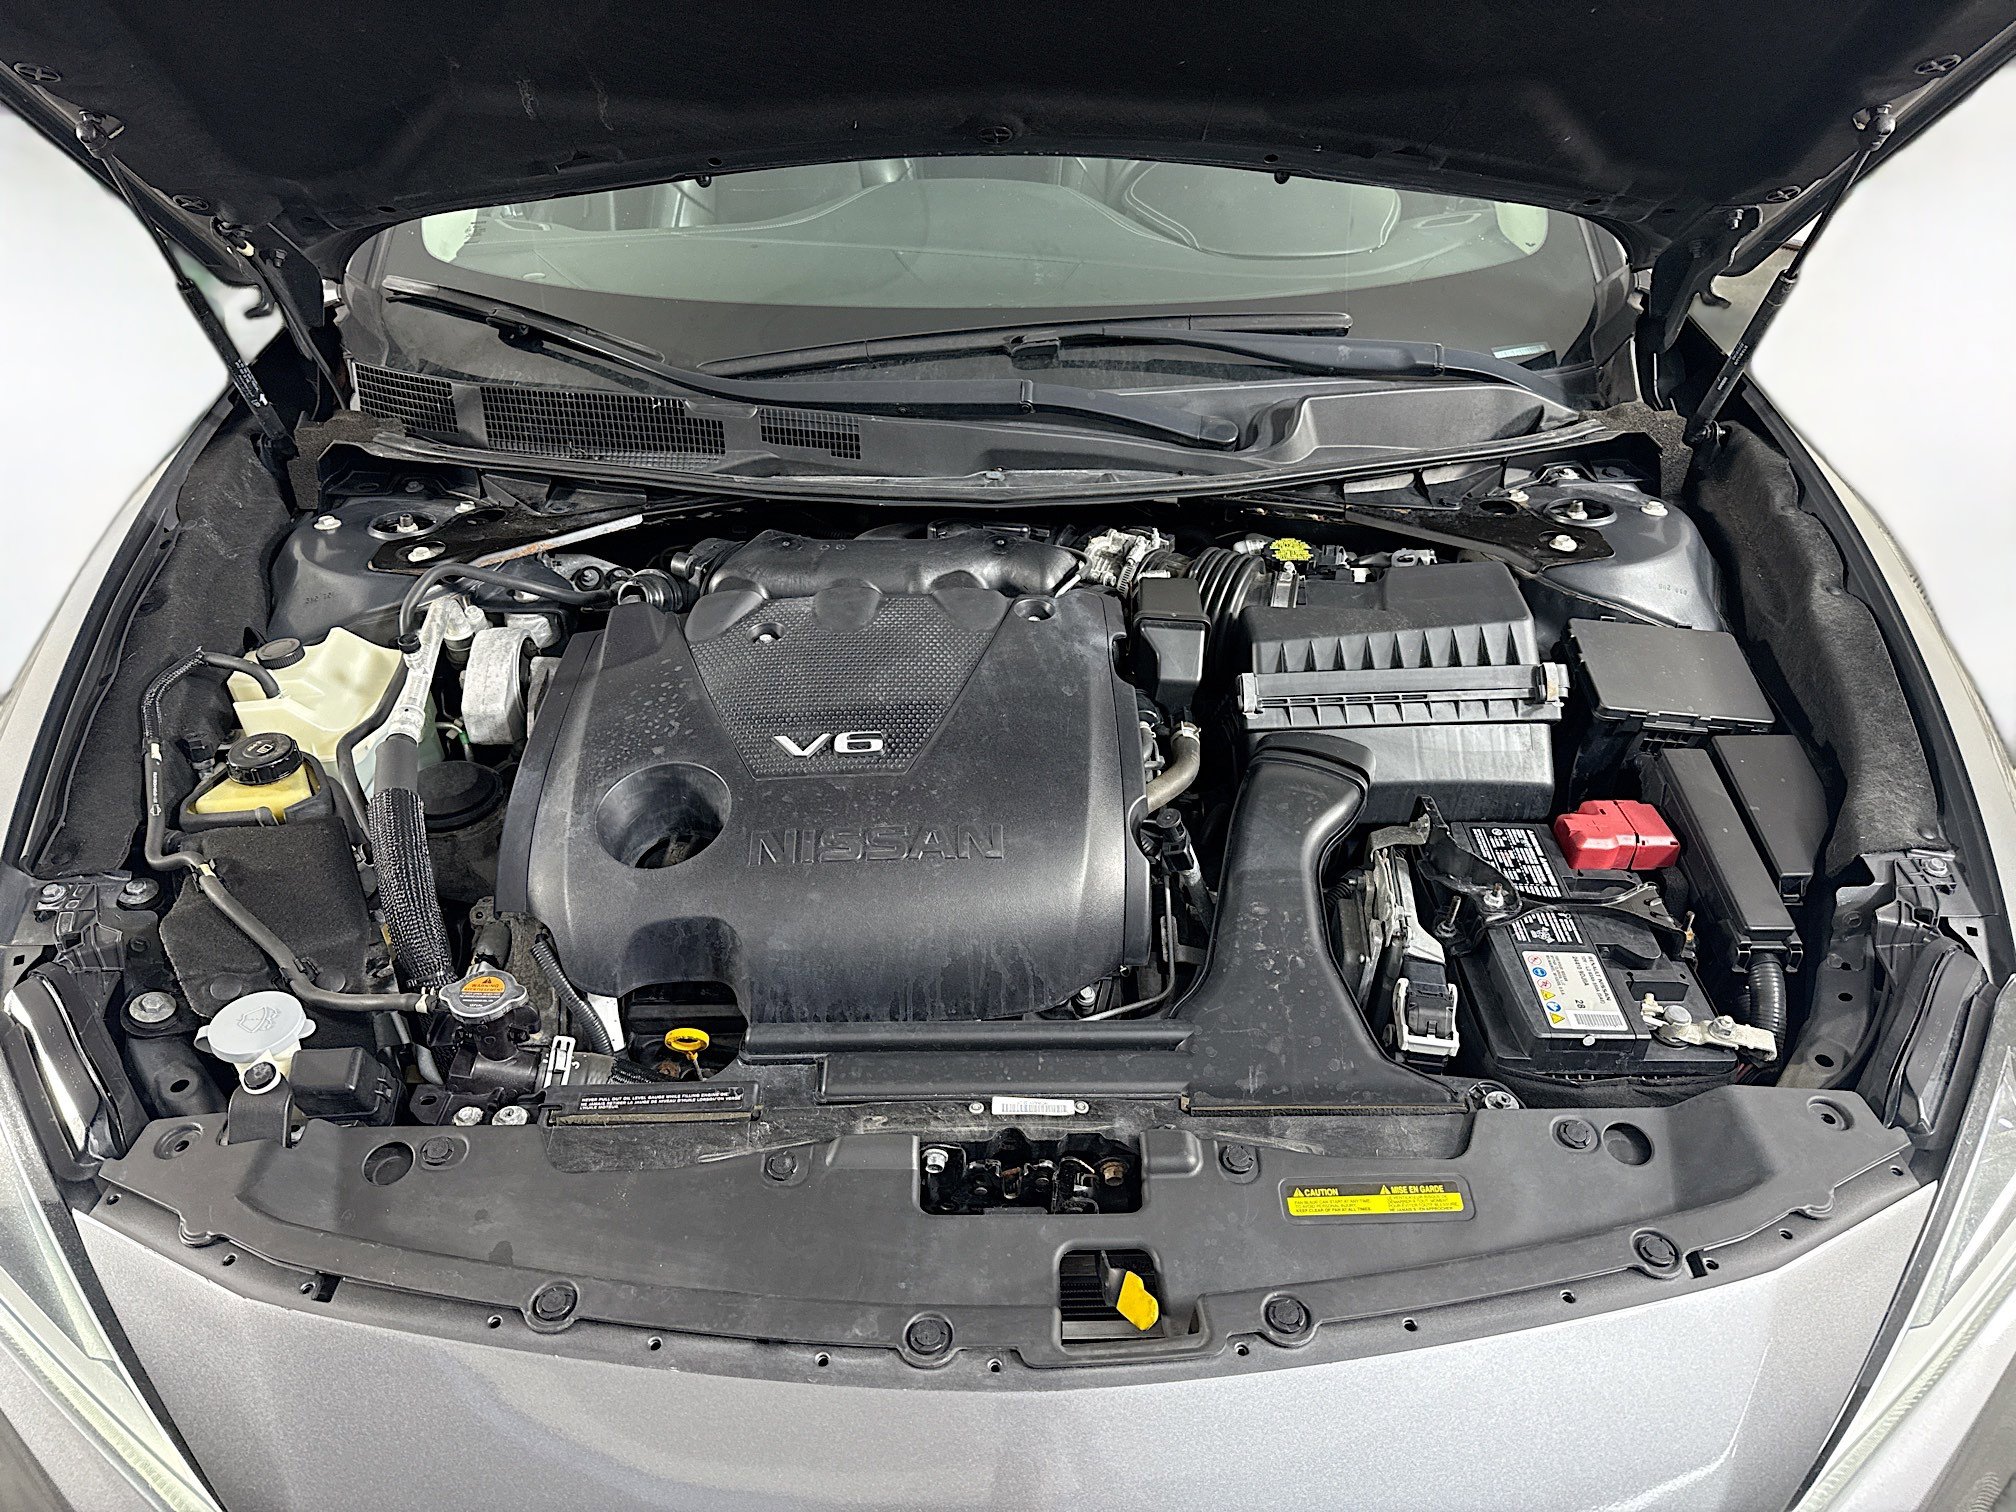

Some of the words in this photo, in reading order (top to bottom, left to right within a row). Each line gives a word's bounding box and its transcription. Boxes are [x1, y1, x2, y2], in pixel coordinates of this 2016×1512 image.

[774, 731, 886, 758] V6
[748, 824, 1004, 866] NISSAN
[1596, 978, 1612, 1001] NISSAN
[1574, 999, 1586, 1008] 28
[1304, 1188, 1338, 1197] CAUTION
[1390, 1186, 1408, 1194] MISE
[1408, 1185, 1419, 1194] EN
[1420, 1184, 1444, 1193] GARDE
